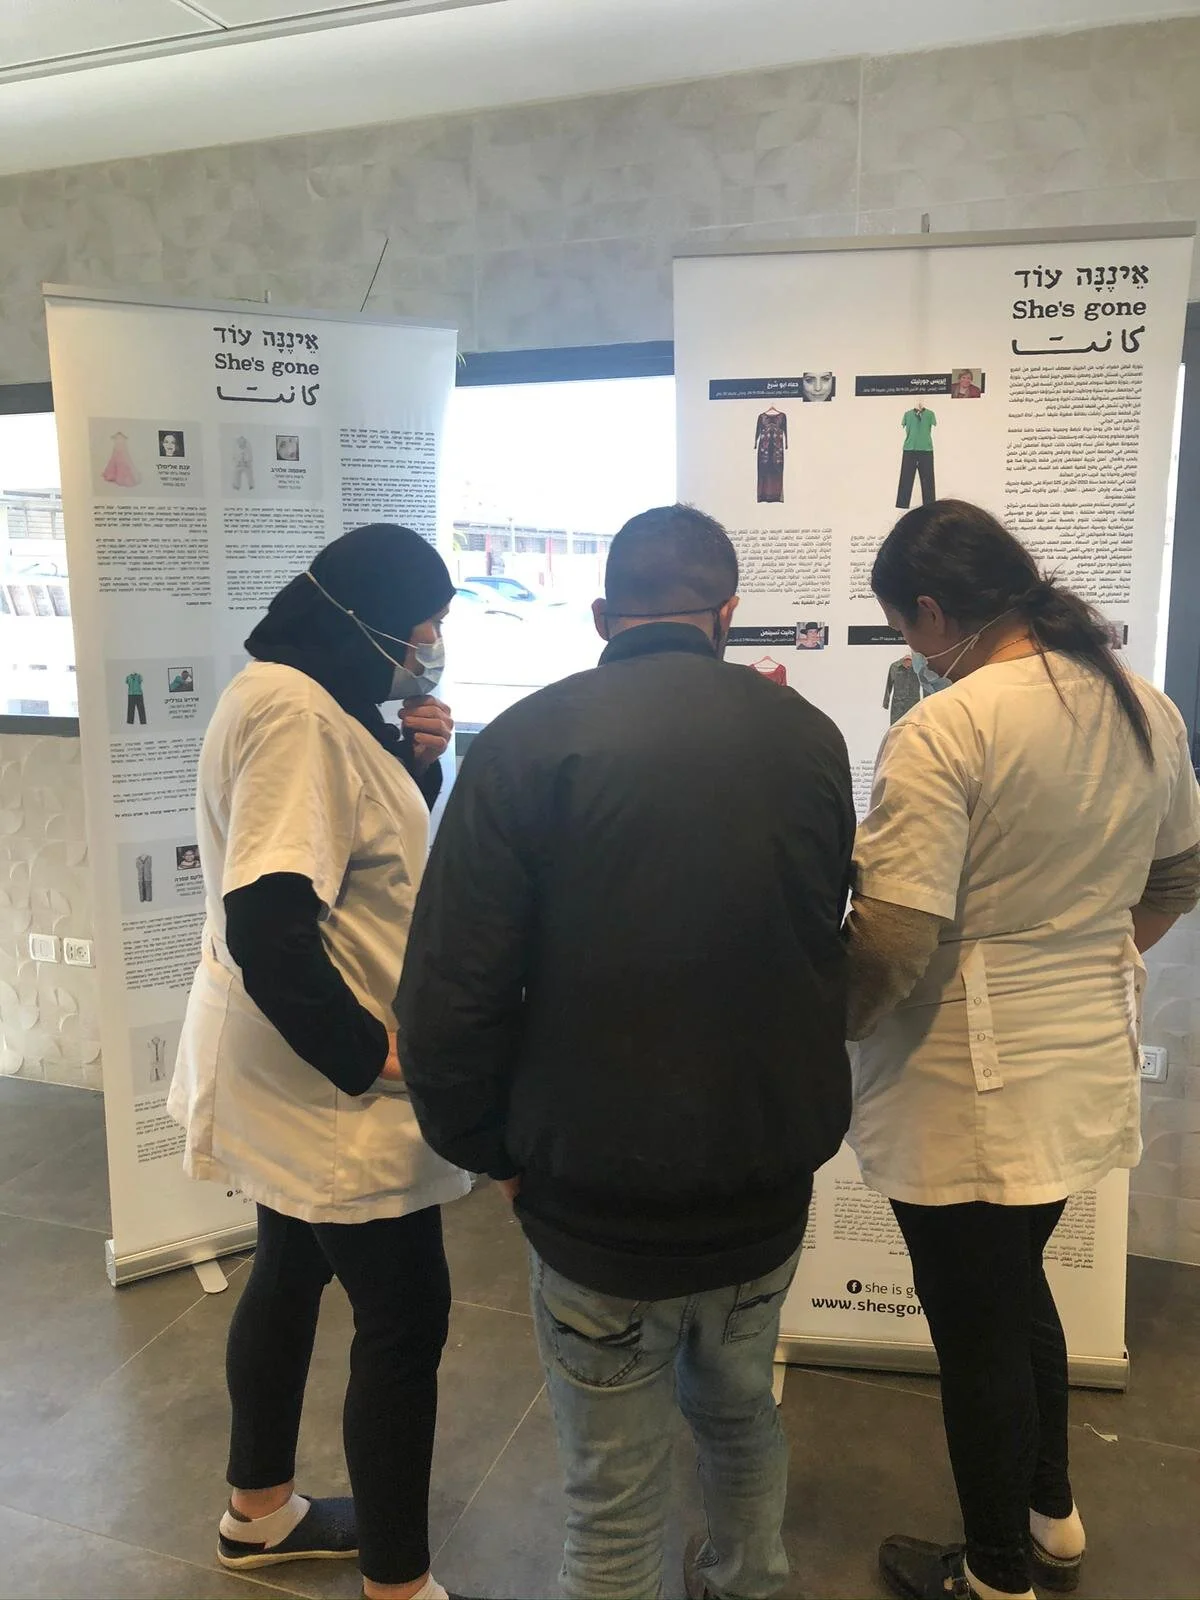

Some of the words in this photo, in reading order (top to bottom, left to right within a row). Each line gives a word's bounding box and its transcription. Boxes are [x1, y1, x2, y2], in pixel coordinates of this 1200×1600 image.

[1012, 299, 1075, 319] She's
[1084, 301, 1147, 321] gone
[1011, 325, 1146, 355] كانت
[215, 353, 265, 372] She's
[272, 361, 319, 377] gone
[216, 384, 320, 406] كانت
[865, 1282, 888, 1294] she
[892, 1284, 902, 1295] is
